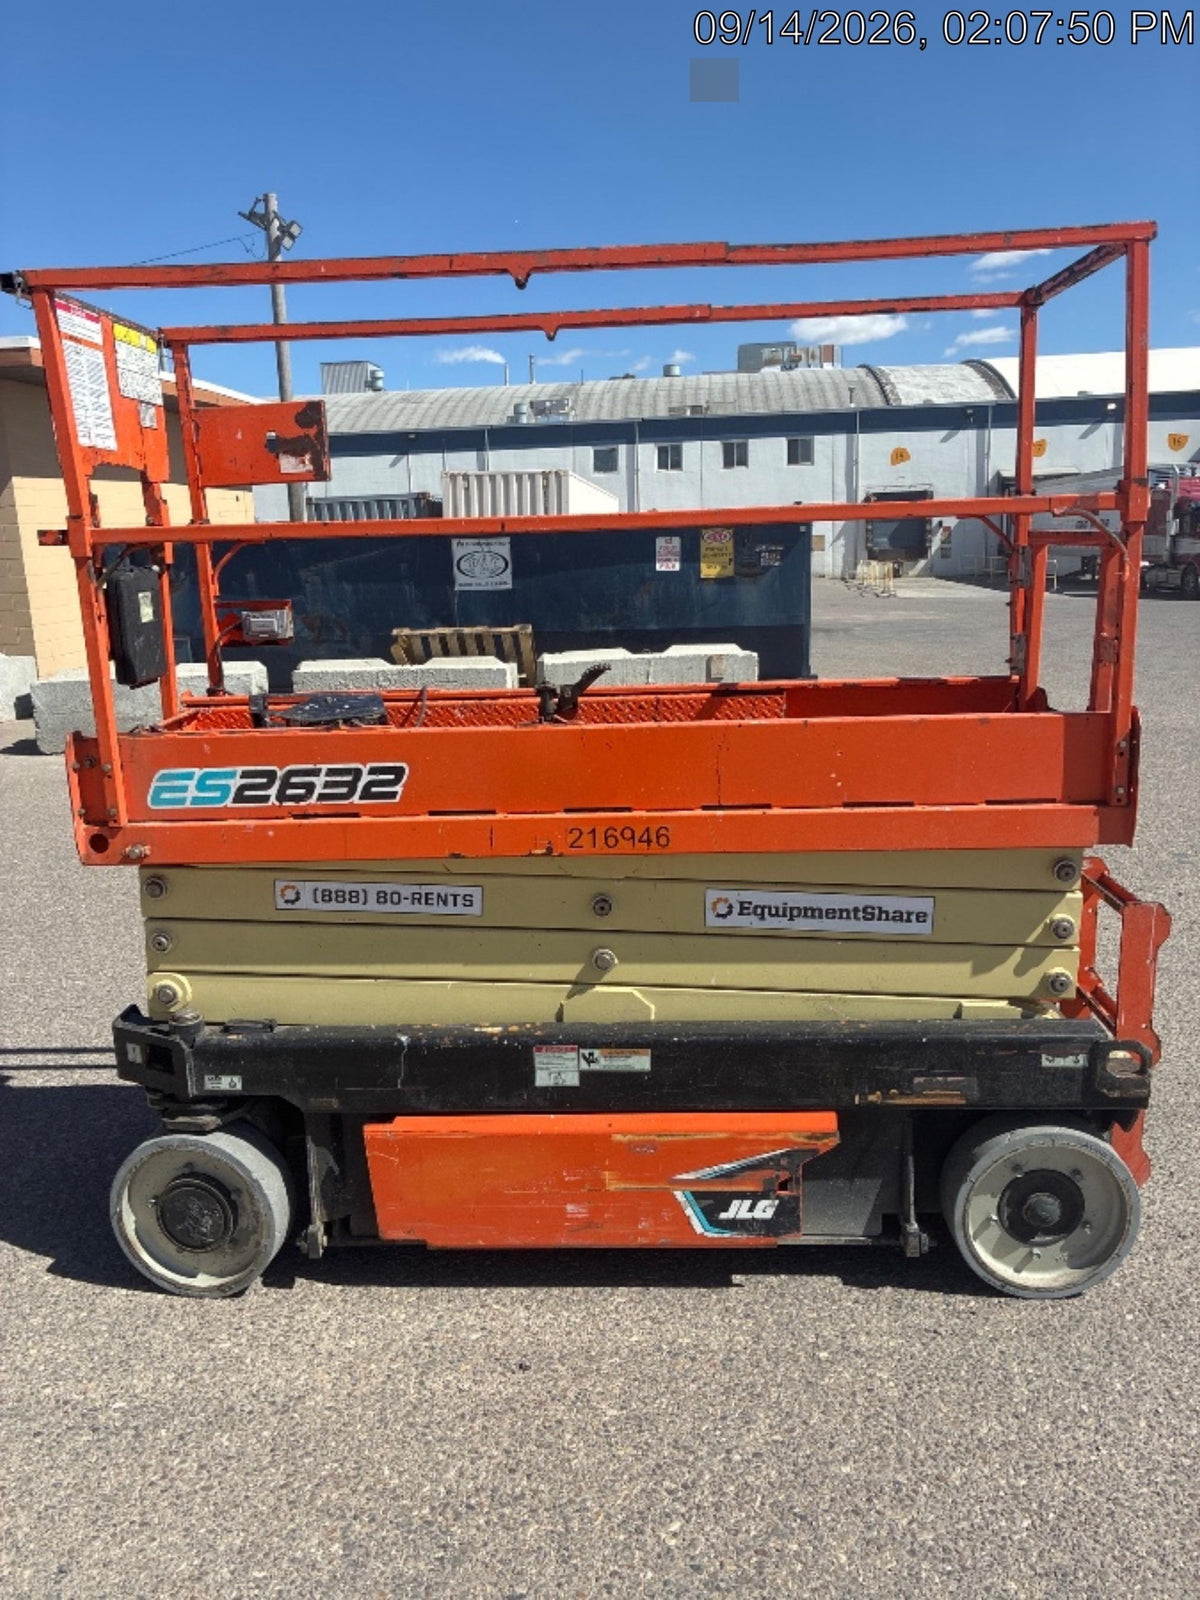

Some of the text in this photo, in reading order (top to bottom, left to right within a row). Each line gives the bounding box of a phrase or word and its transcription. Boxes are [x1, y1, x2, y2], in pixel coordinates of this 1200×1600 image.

[147, 763, 408, 808] ES2632
[568, 826, 671, 849] 216946
[312, 887, 475, 908] (888) 80-RENTS
[737, 900, 929, 923] EquipmentShare
[718, 1199, 779, 1220] JLG
